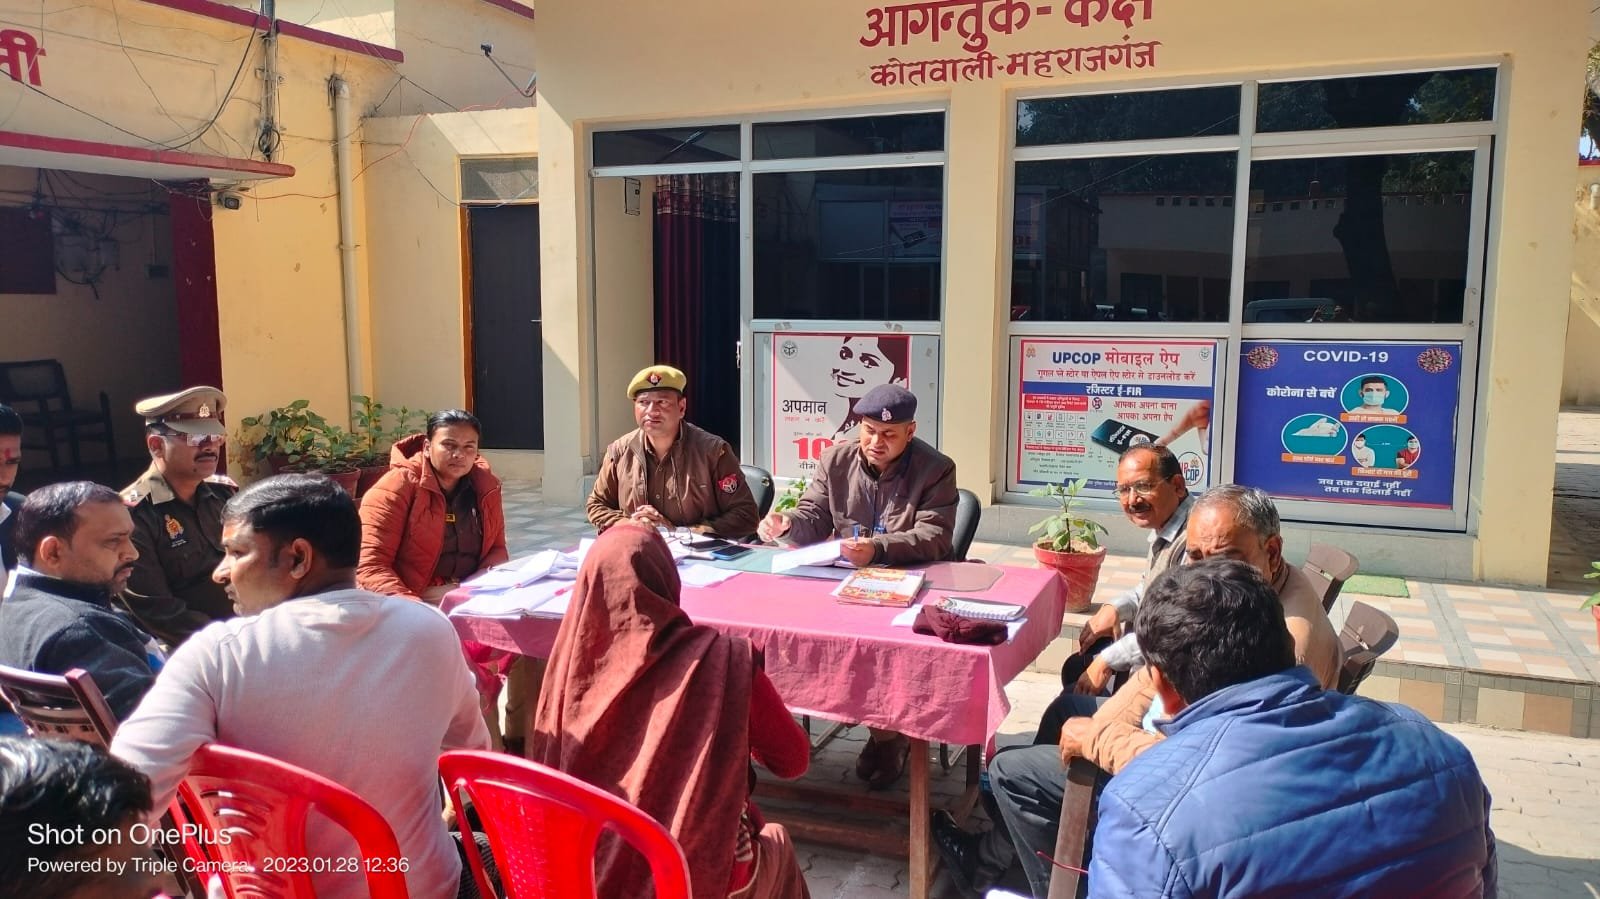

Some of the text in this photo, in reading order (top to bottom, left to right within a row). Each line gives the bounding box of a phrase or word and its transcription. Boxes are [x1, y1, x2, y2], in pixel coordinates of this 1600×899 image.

[1052, 347, 1180, 370] UPCOP मोबाइल ऐप
[1303, 350, 1389, 363] COVID-19
[1086, 384, 1142, 396] रजिस्टर ई-FIR
[1266, 385, 1338, 399] कोरोना से बचें
[782, 399, 827, 415] अपमान
[1114, 400, 1136, 409] आपका
[1139, 401, 1158, 409] अपना
[1117, 412, 1139, 420] आपका
[1142, 413, 1161, 421] अपना
